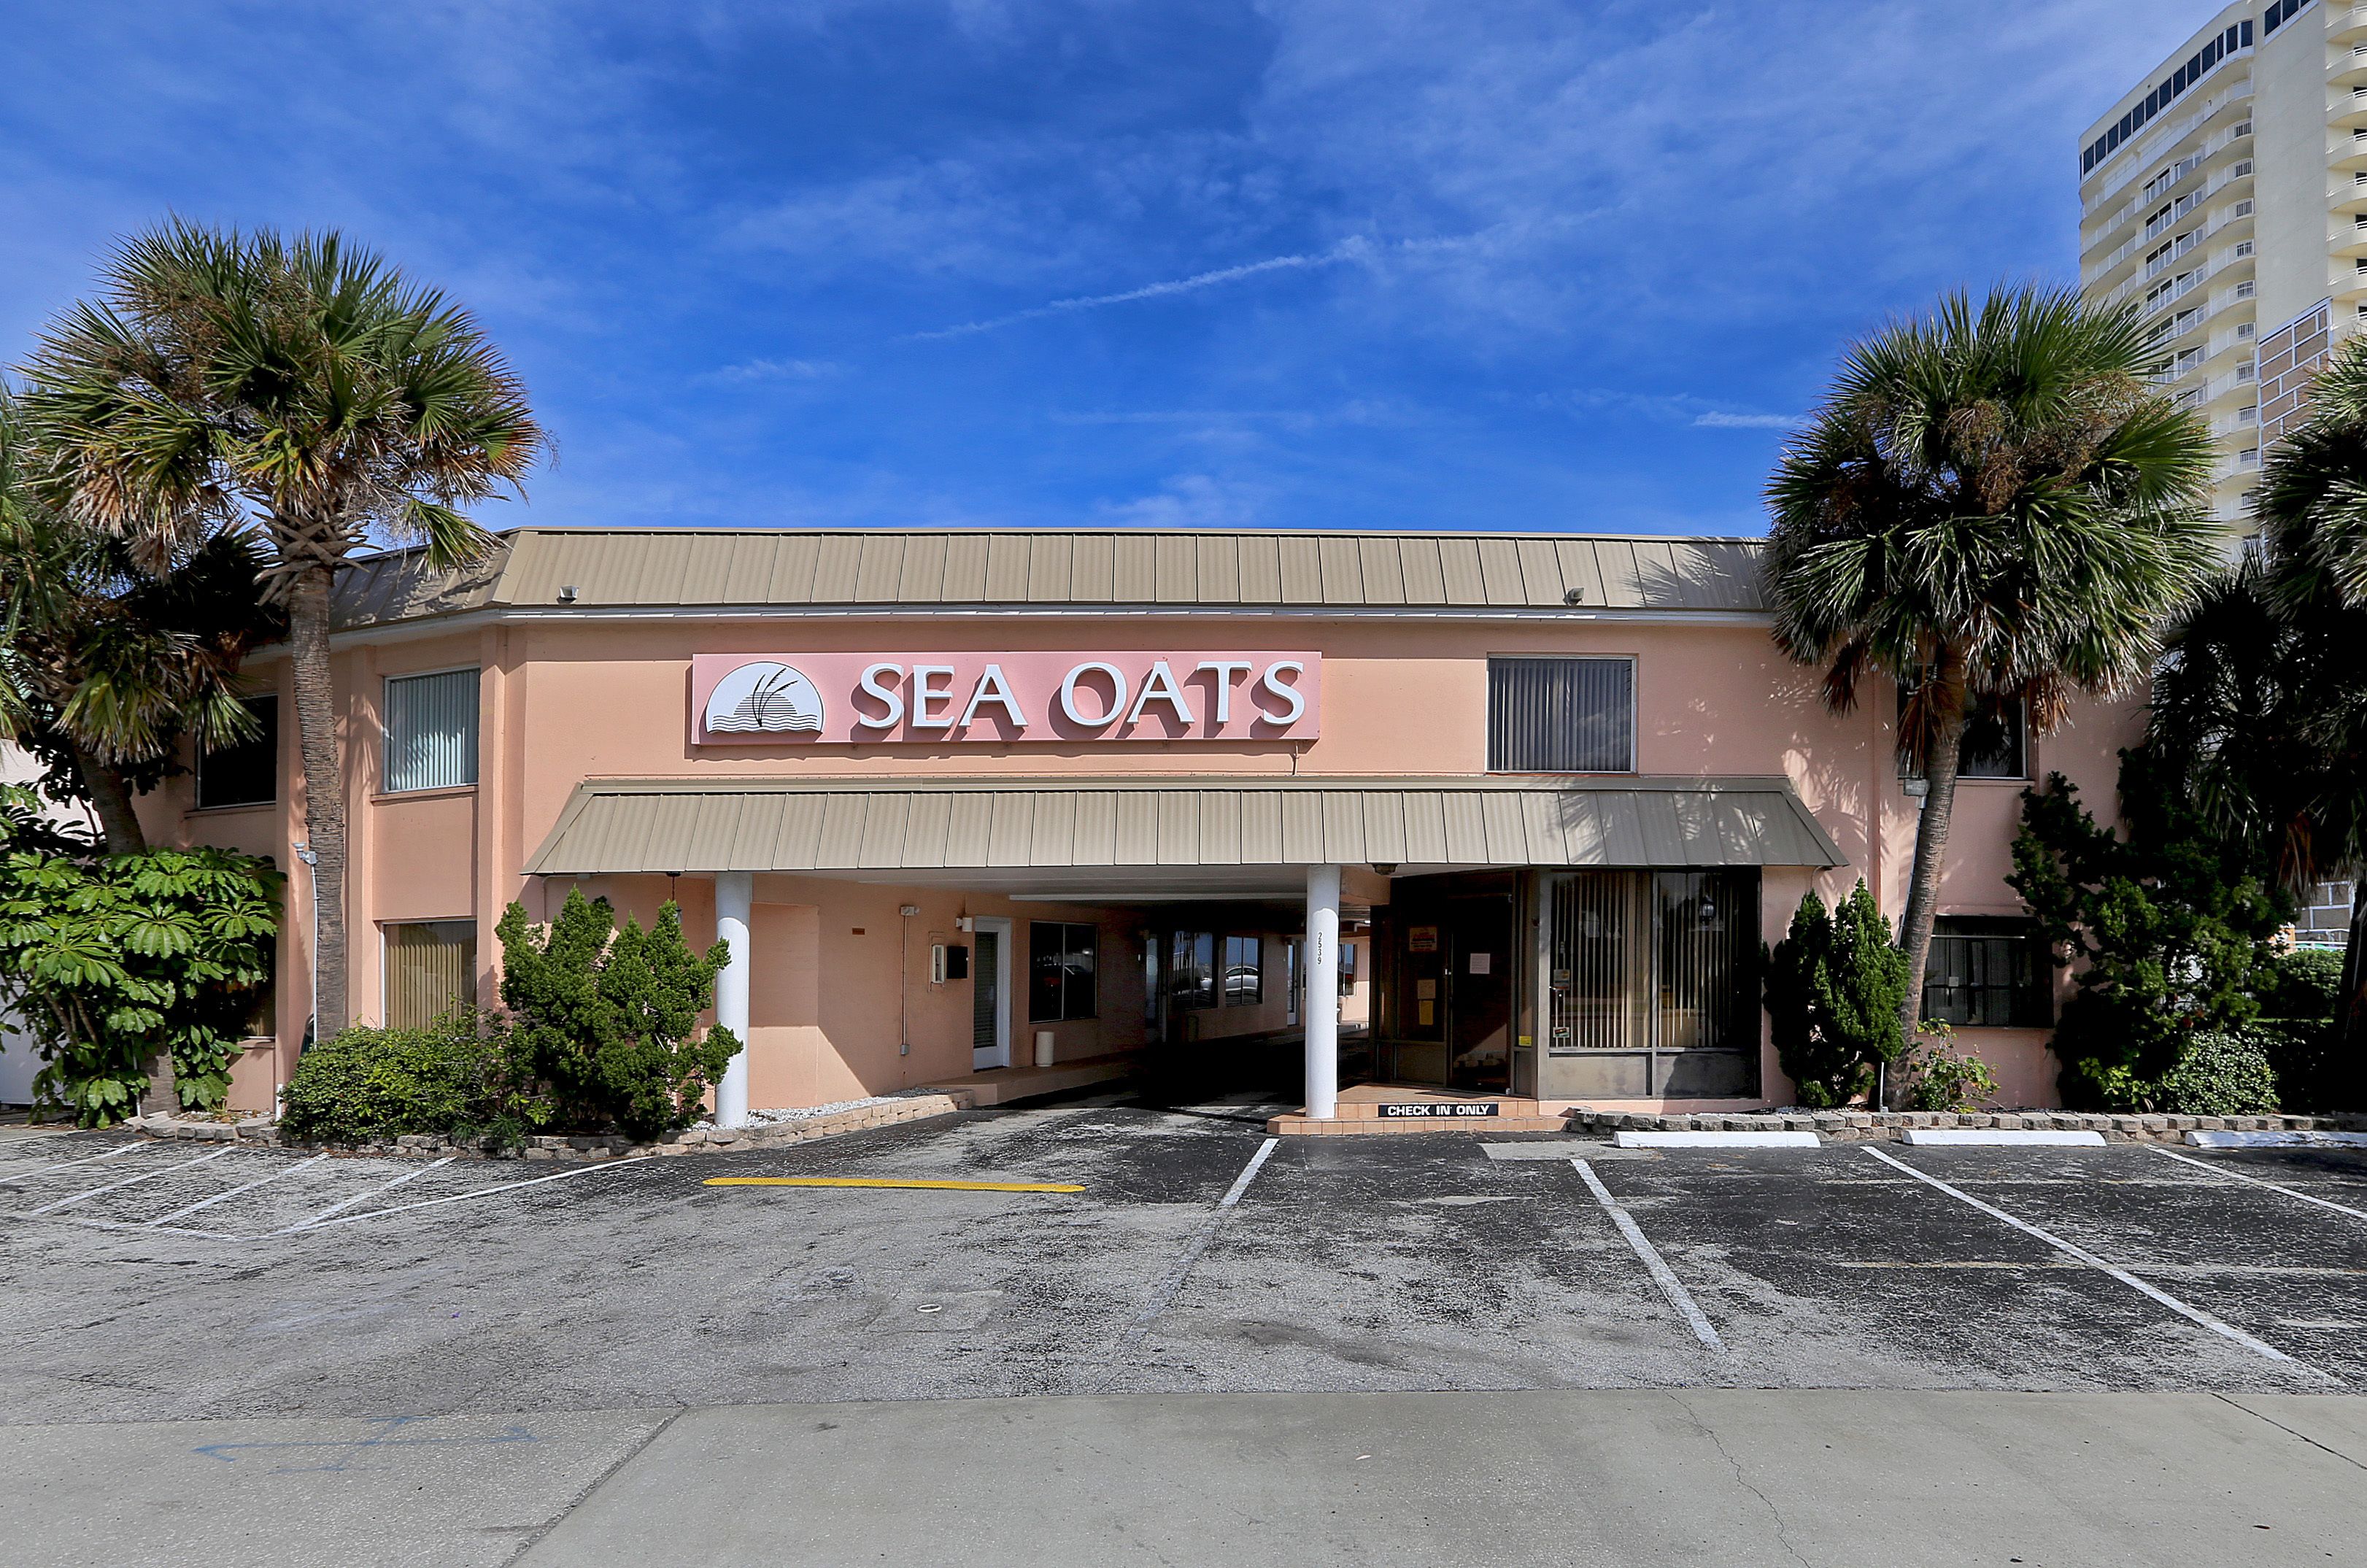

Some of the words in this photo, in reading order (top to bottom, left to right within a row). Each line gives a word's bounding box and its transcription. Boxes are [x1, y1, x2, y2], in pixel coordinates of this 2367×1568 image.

[860, 662, 1029, 730] SEA
[1060, 660, 1305, 727] OATS
[1387, 1105, 1430, 1116] CHECK
[1436, 1105, 1451, 1116] IN
[1456, 1105, 1489, 1116] ONLY
